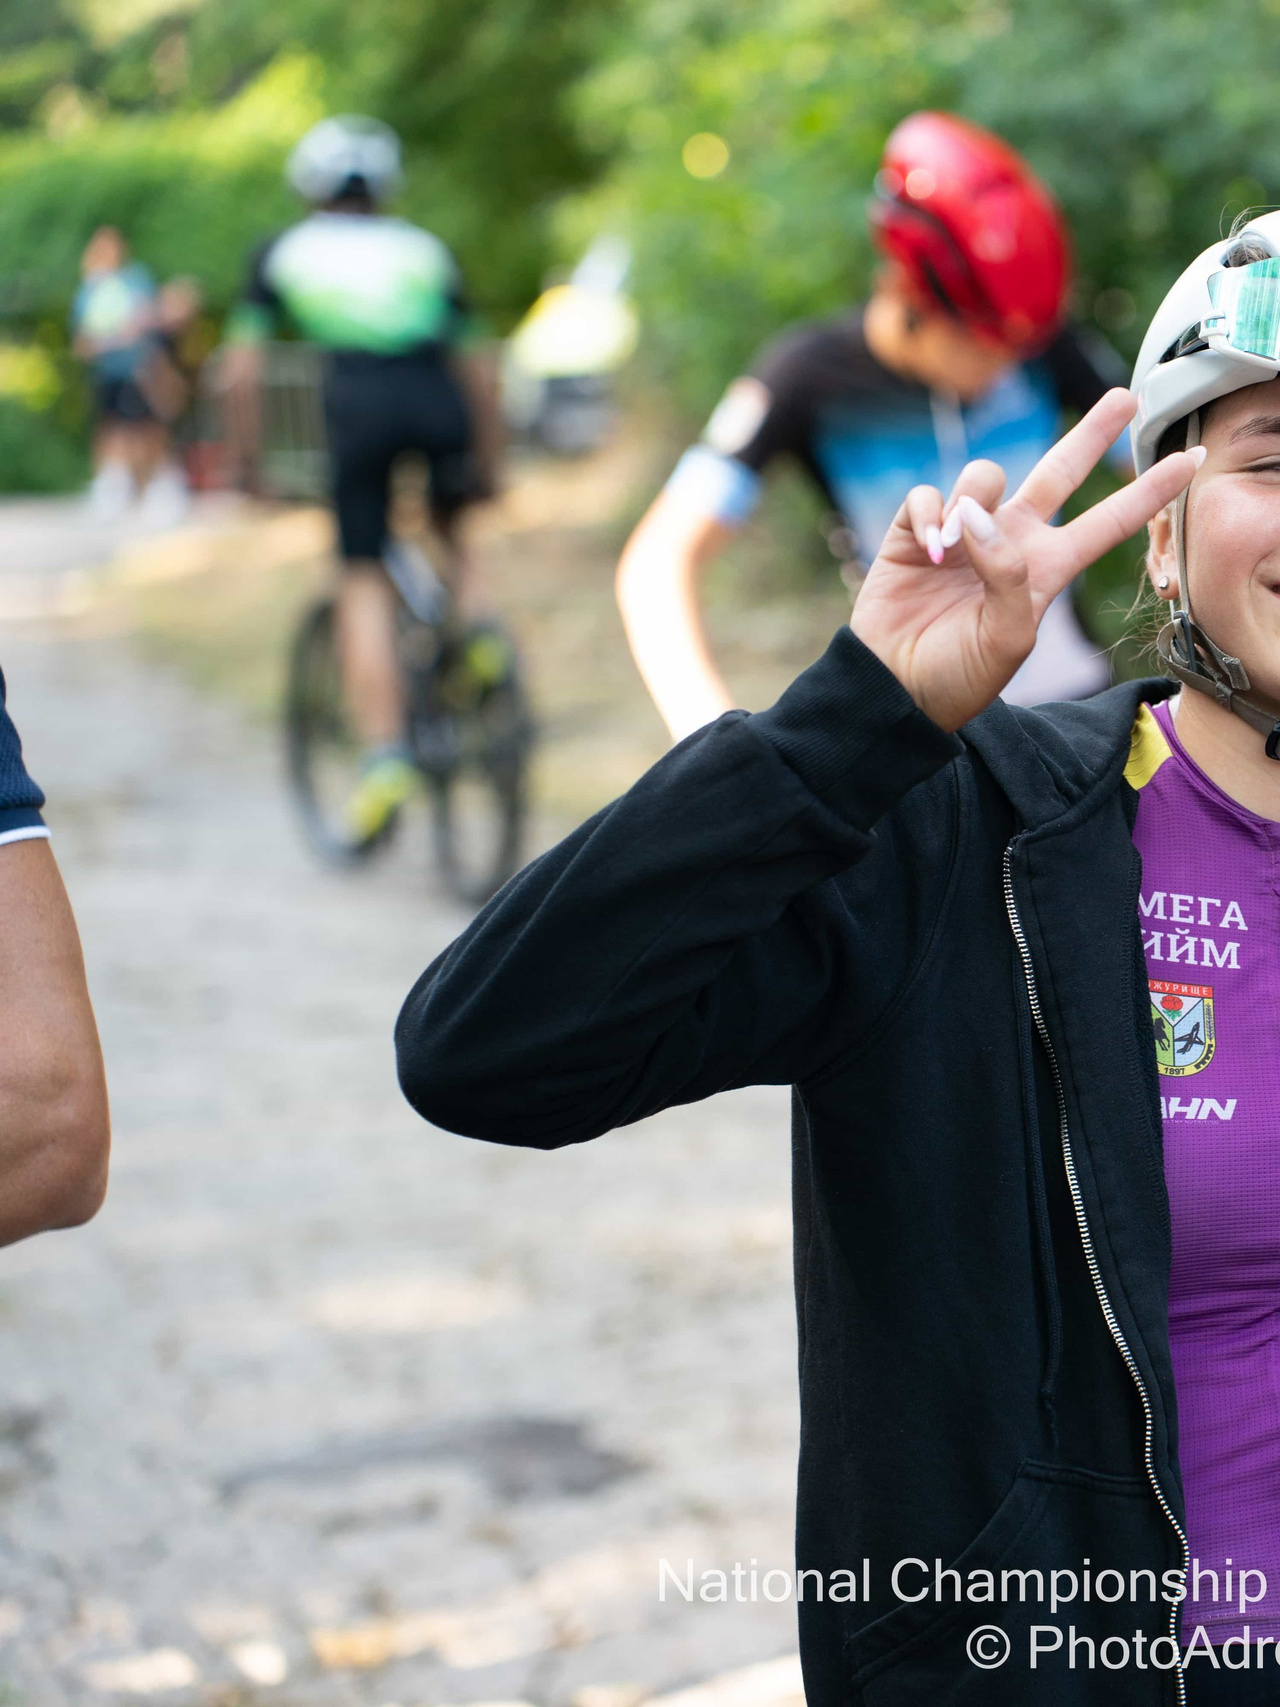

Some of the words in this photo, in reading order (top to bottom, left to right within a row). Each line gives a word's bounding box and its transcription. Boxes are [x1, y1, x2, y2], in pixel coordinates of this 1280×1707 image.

[1139, 891, 1248, 931] МЕГА
[1148, 982, 1209, 995] ЖУРИЩЕ
[1164, 1067, 1185, 1075] 1897
